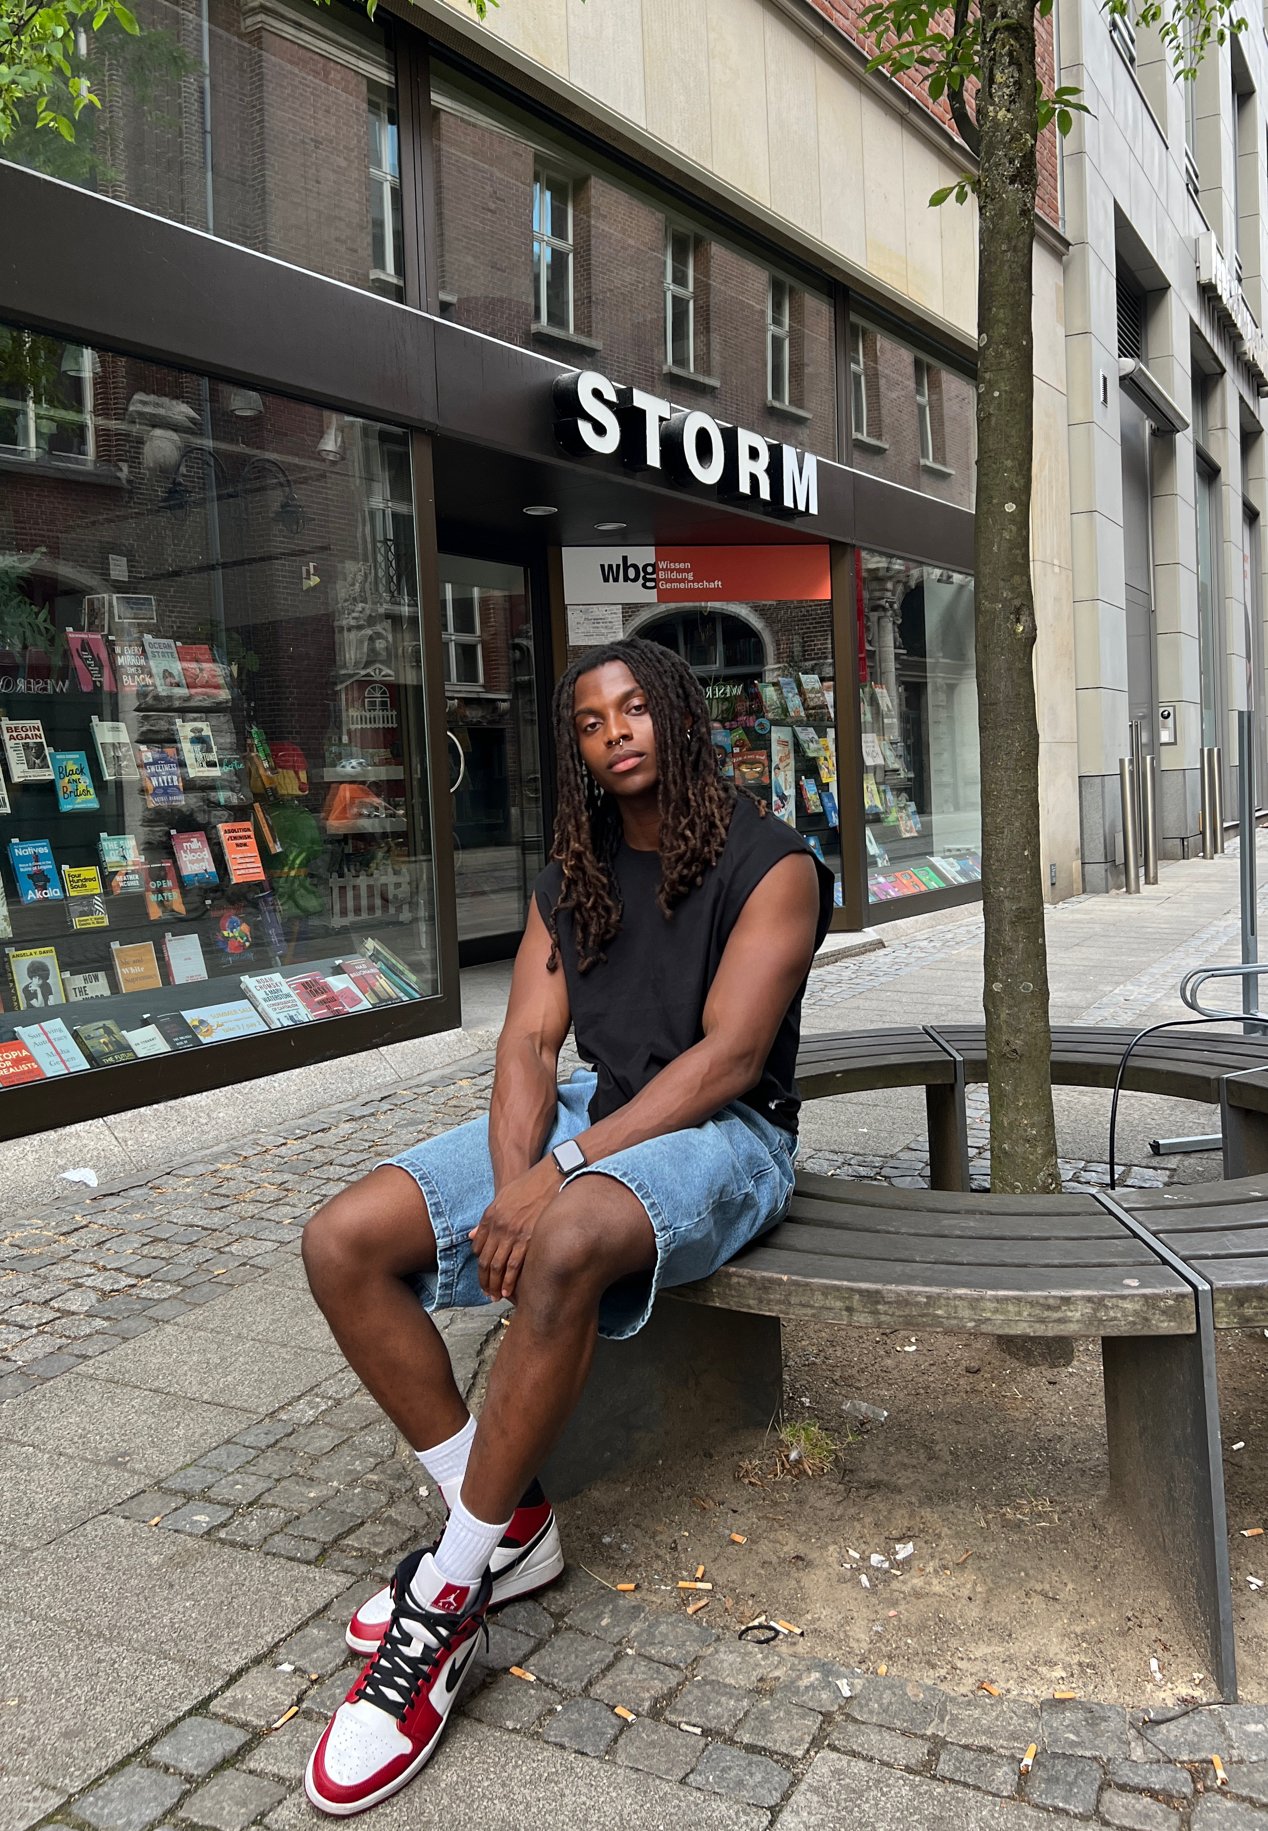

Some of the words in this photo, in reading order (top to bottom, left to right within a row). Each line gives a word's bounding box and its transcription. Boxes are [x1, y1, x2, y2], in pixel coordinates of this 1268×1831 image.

[577, 370, 818, 515] STORM
[658, 561, 690, 569] Wissen
[600, 555, 657, 590] wbg
[658, 571, 693, 580] Bildung
[658, 580, 722, 589] Gemeinschaft
[124, 646, 143, 655] EVERY
[148, 642, 172, 650] OCEAN
[151, 651, 176, 659] STATE
[117, 655, 146, 666] MIRROR
[122, 674, 154, 686] BLACK
[6, 725, 41, 734] BEGIN
[9, 733, 43, 741] AGAIN
[58, 764, 86, 780] Black
[146, 763, 177, 773] SWEETNESS
[150, 775, 179, 787] WATER
[61, 786, 92, 800] British
[103, 841, 118, 849] THE
[182, 837, 202, 850] milk
[14, 846, 49, 857] Natives
[180, 848, 209, 861] blood
[186, 860, 209, 871] heat
[69, 876, 96, 885] Hundred
[149, 879, 173, 889] OPEN
[70, 882, 88, 890] Souls
[27, 887, 61, 900] Akala
[150, 891, 177, 902] WATER
[122, 966, 144, 975] White
[83, 973, 100, 984] HOW
[255, 976, 273, 984] NOAM
[254, 981, 283, 991] CHOMSKY
[72, 987, 89, 998] THE
[27, 1027, 64, 1039] Surving
[102, 1056, 115, 1064] THE
[0, 1062, 38, 1076] REALISTS
[438, 1601, 455, 1610] AIR
